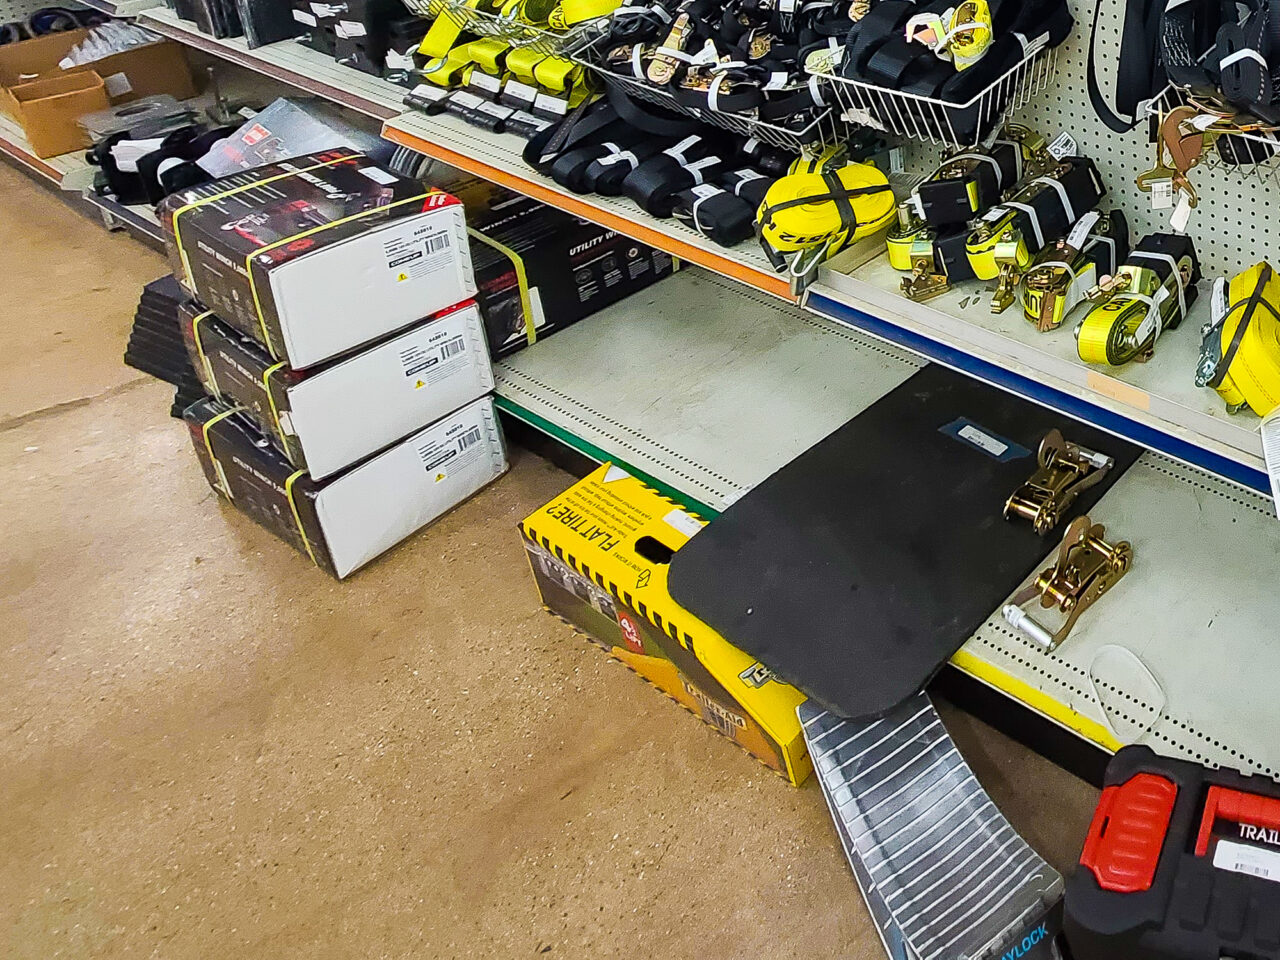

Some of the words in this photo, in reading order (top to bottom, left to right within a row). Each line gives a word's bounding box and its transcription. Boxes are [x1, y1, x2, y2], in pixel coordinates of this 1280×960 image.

[569, 236, 604, 256] UTILITY
[545, 503, 588, 533] TIRE?
[578, 524, 620, 552] FLAT
